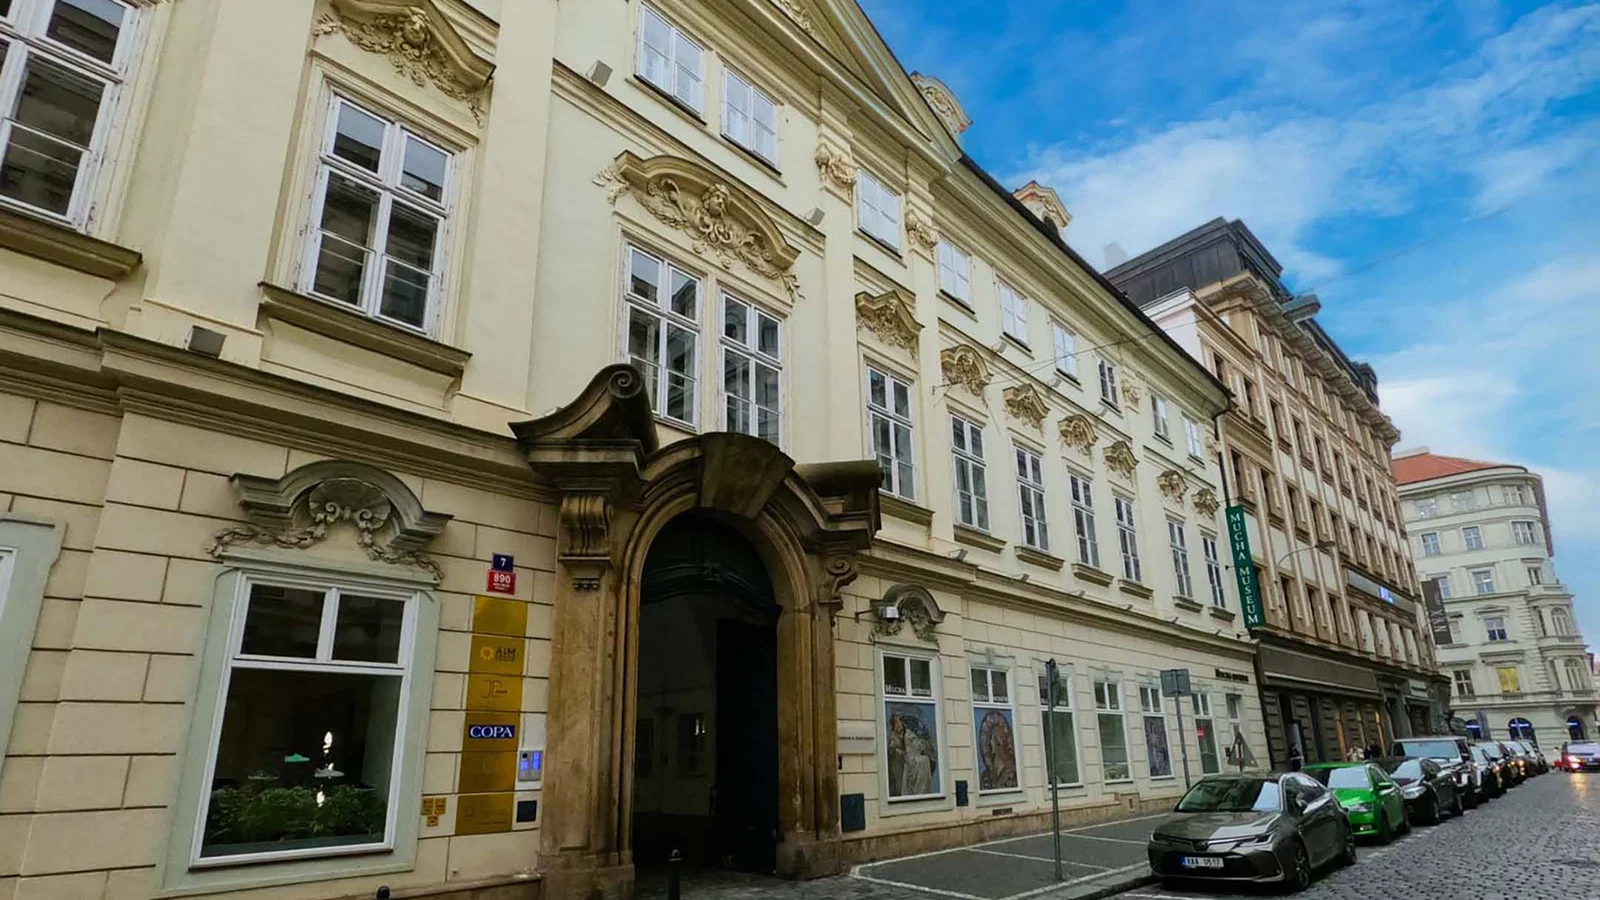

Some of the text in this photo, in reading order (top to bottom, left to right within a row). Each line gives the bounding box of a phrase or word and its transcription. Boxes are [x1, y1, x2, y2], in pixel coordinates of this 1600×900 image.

[500, 557, 507, 567] 7
[1230, 513, 1259, 624] MUCHA MUSEUM
[493, 573, 511, 584] 890
[470, 725, 513, 738] COPA
